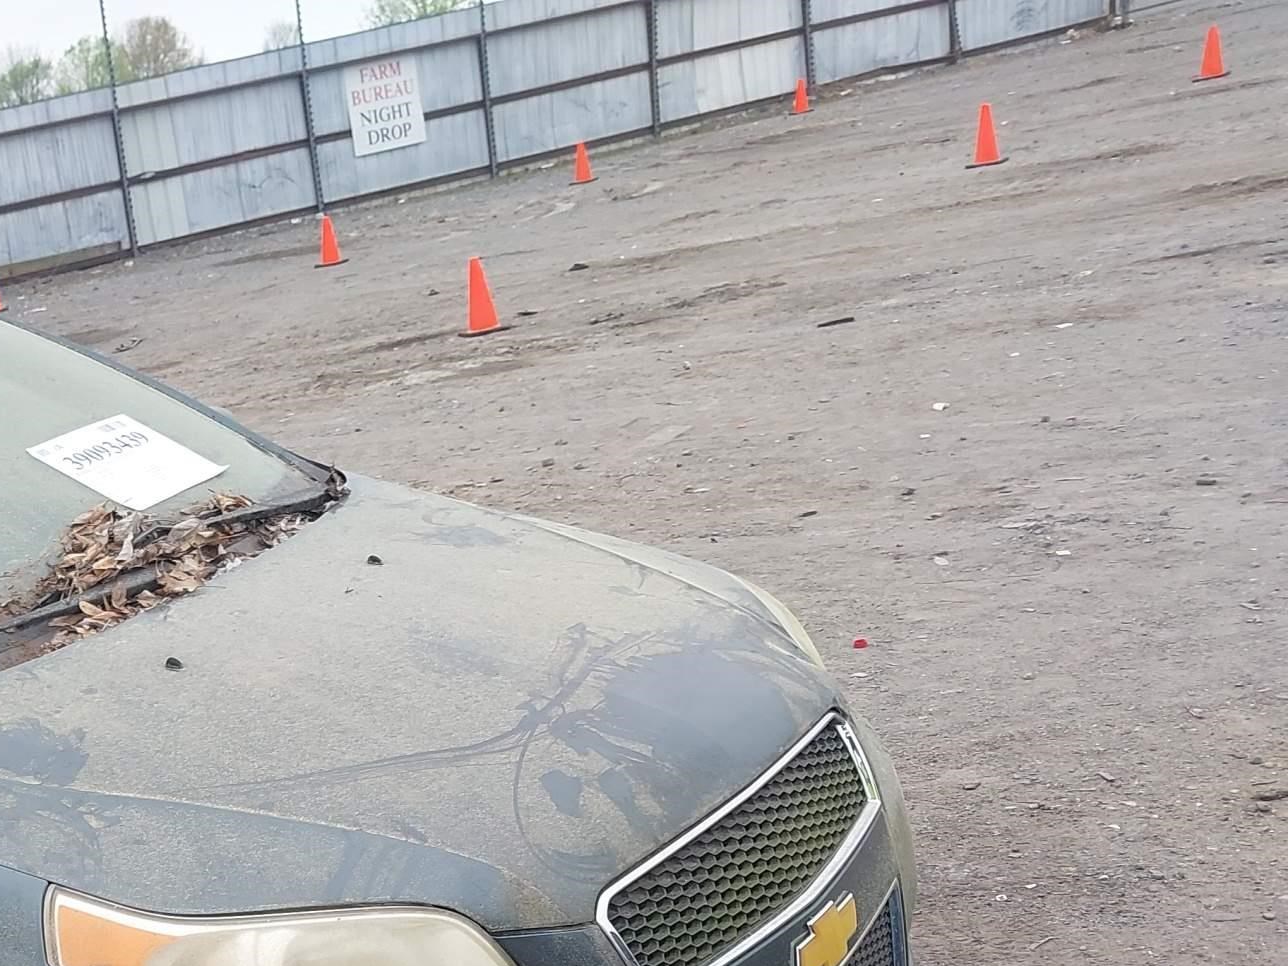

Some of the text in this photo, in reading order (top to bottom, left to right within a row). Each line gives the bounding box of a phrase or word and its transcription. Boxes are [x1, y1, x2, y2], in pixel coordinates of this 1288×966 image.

[360, 61, 401, 84] FARM
[352, 79, 414, 106] BUREAU
[360, 102, 412, 127] NIGHT
[368, 122, 412, 145] DROP
[62, 431, 149, 470] 39093439
